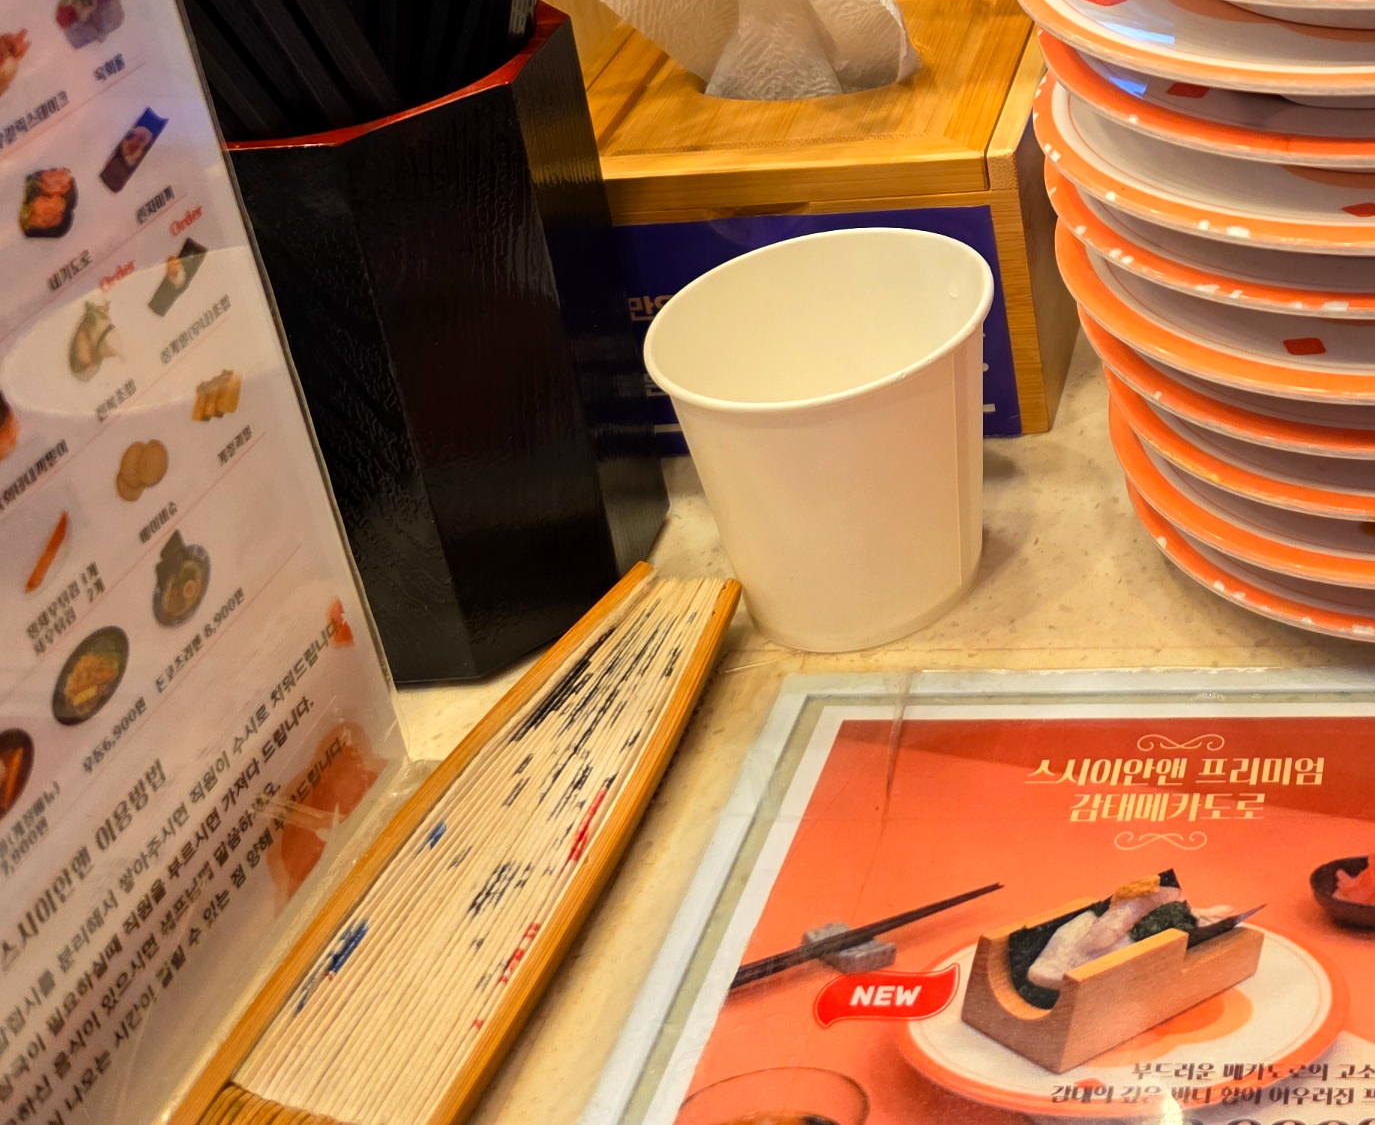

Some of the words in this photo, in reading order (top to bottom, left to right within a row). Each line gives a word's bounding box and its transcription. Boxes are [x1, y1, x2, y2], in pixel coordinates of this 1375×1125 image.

[187, 753, 233, 807] 직원이
[230, 707, 272, 758] 수시로
[1024, 757, 1188, 787] 스시이안앤
[1194, 756, 1326, 786] 프리미엄
[94, 757, 168, 854] 이용방법
[1068, 792, 1267, 823] 감태메카도로
[121, 880, 168, 941] 직원을
[166, 803, 223, 884] 부르시면
[221, 756, 262, 818] 가져다
[185, 919, 204, 946] 수
[228, 860, 249, 892] 점
[244, 829, 275, 869] 양해
[849, 985, 923, 1007] NEW
[1131, 1062, 1217, 1081] 부드러운
[1219, 1085, 1263, 1105] 향이
[1267, 1086, 1356, 1106] 어우러진
